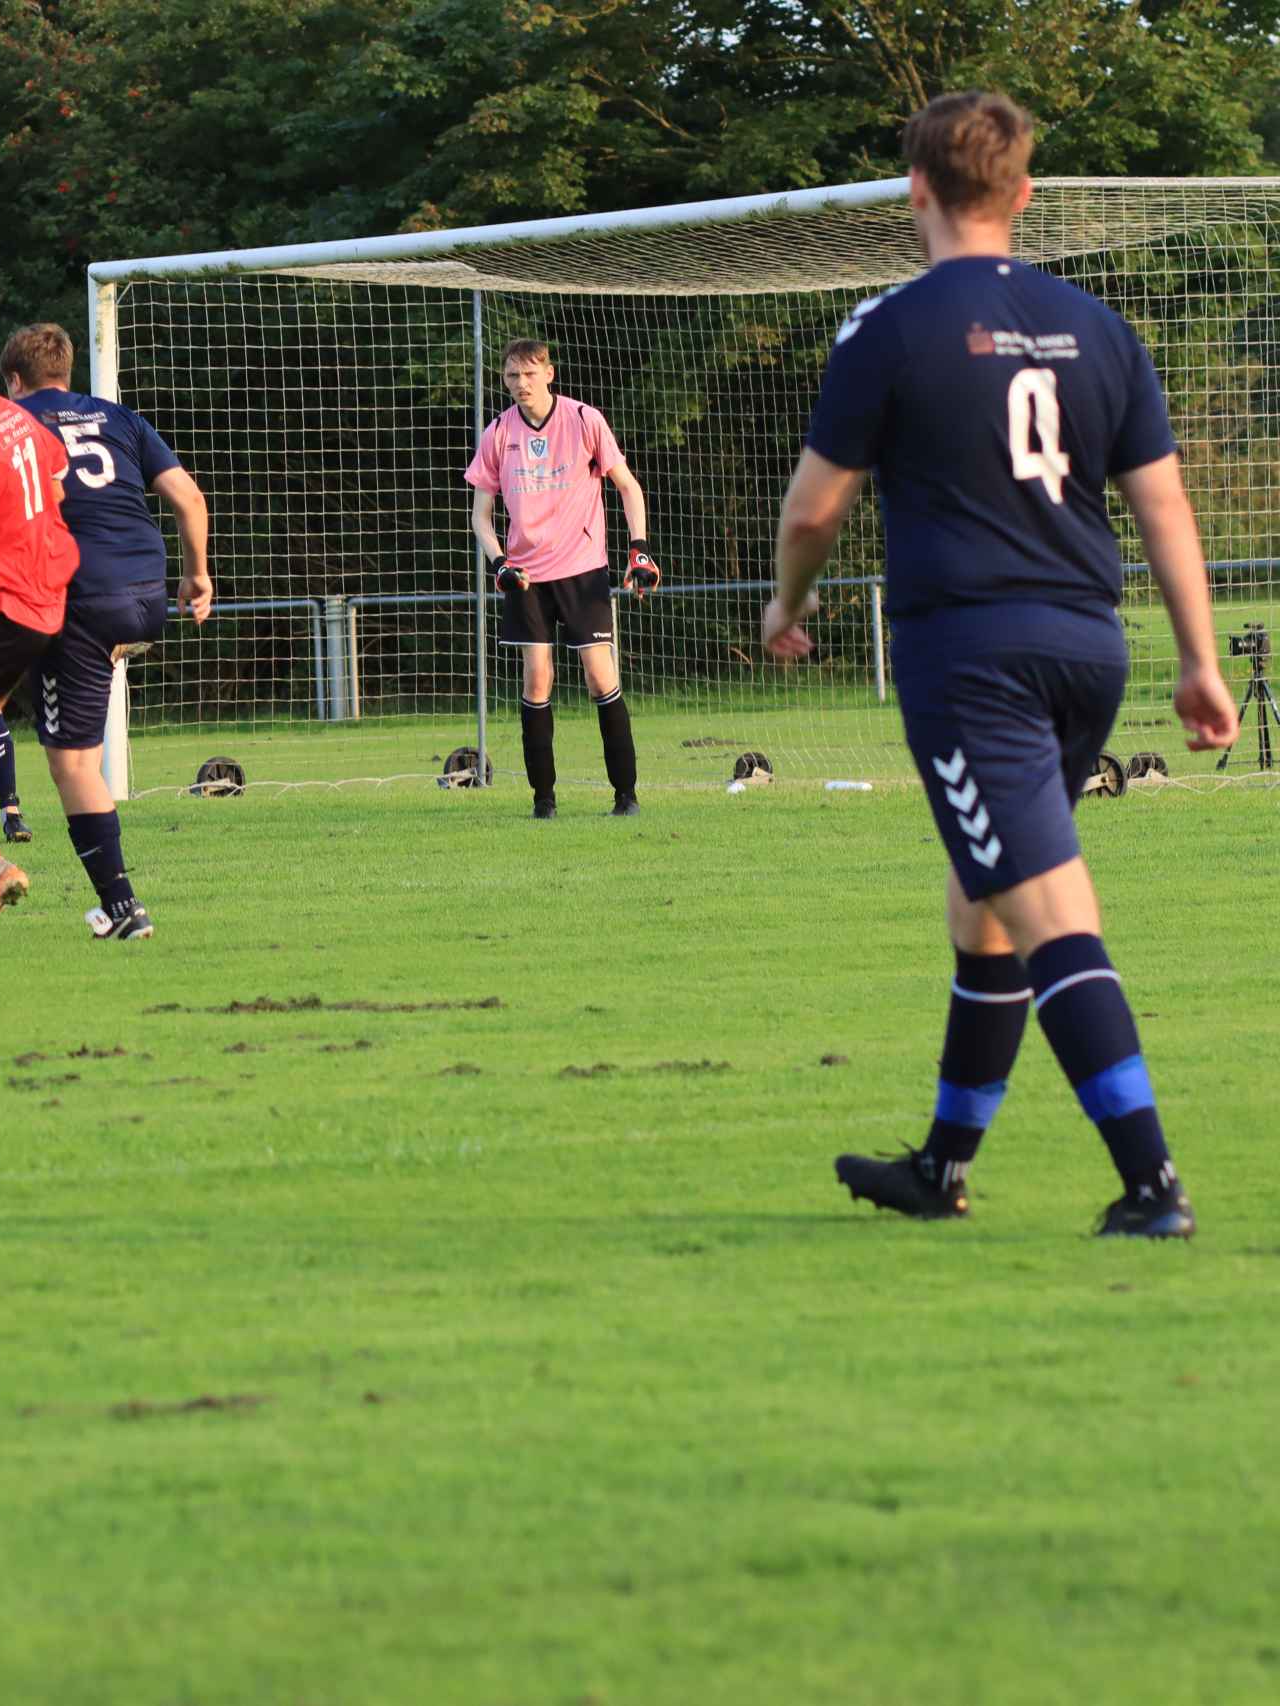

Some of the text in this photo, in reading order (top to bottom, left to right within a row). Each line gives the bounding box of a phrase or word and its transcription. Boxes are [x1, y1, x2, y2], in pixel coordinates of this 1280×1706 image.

[58, 424, 116, 488] 5
[1008, 368, 1069, 504] 4
[11, 437, 44, 520] 11
